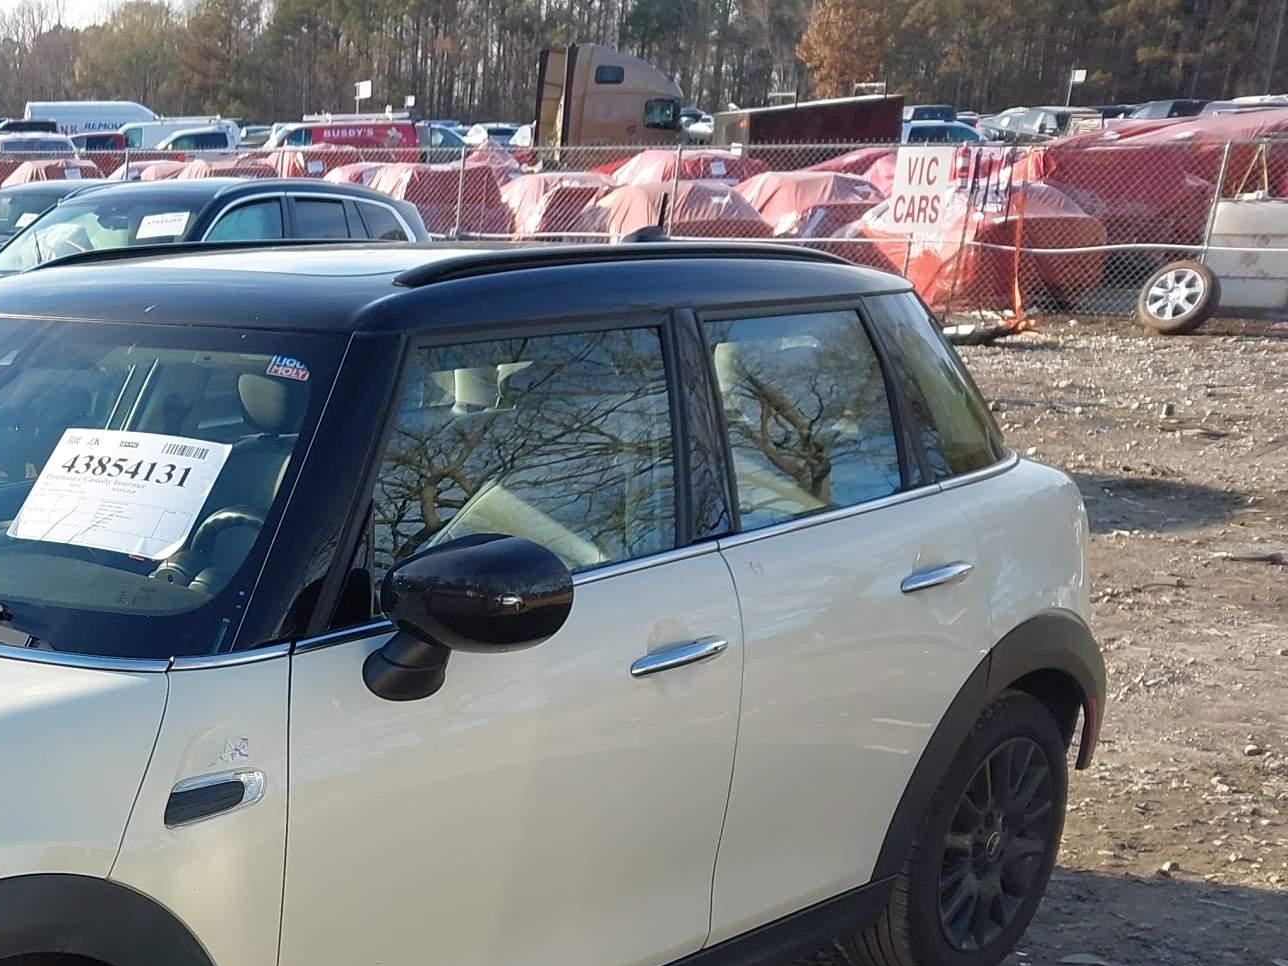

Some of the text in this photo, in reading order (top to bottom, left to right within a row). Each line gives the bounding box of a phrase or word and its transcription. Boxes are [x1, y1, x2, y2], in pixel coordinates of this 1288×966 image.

[324, 128, 373, 137] BUSBY'S
[908, 156, 939, 185] VIC
[894, 194, 940, 223] CARS
[271, 364, 307, 378] MOLY
[62, 454, 192, 488] 43854131
